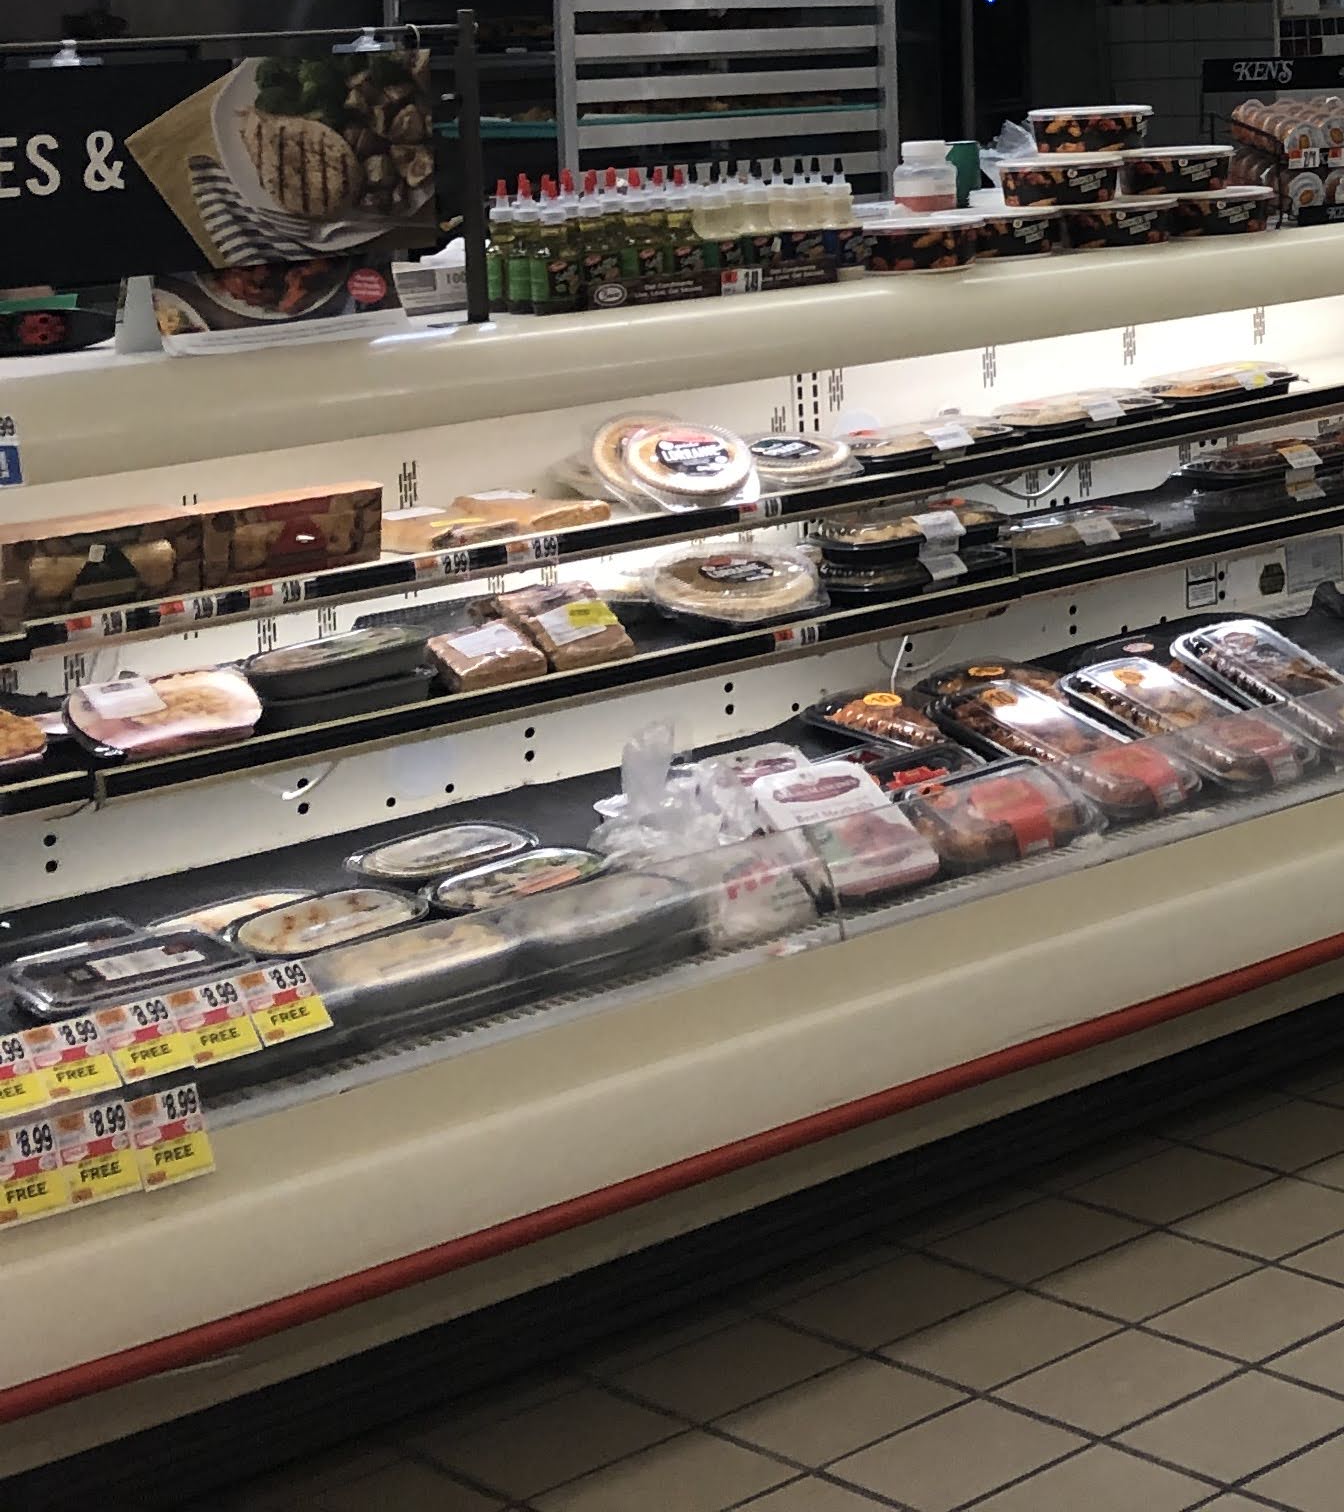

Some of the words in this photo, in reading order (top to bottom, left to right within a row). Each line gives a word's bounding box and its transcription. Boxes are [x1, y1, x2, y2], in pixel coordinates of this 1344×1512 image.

[1232, 59, 1295, 84] KEN'S
[83, 129, 127, 191] &
[269, 1006, 311, 1027] FREE
[199, 1027, 240, 1046] FREE
[129, 1043, 172, 1064] FREE
[55, 1063, 98, 1083] FREE
[153, 1144, 195, 1166] FREE
[79, 1160, 123, 1183] FREE
[6, 1180, 48, 1204] FREE
